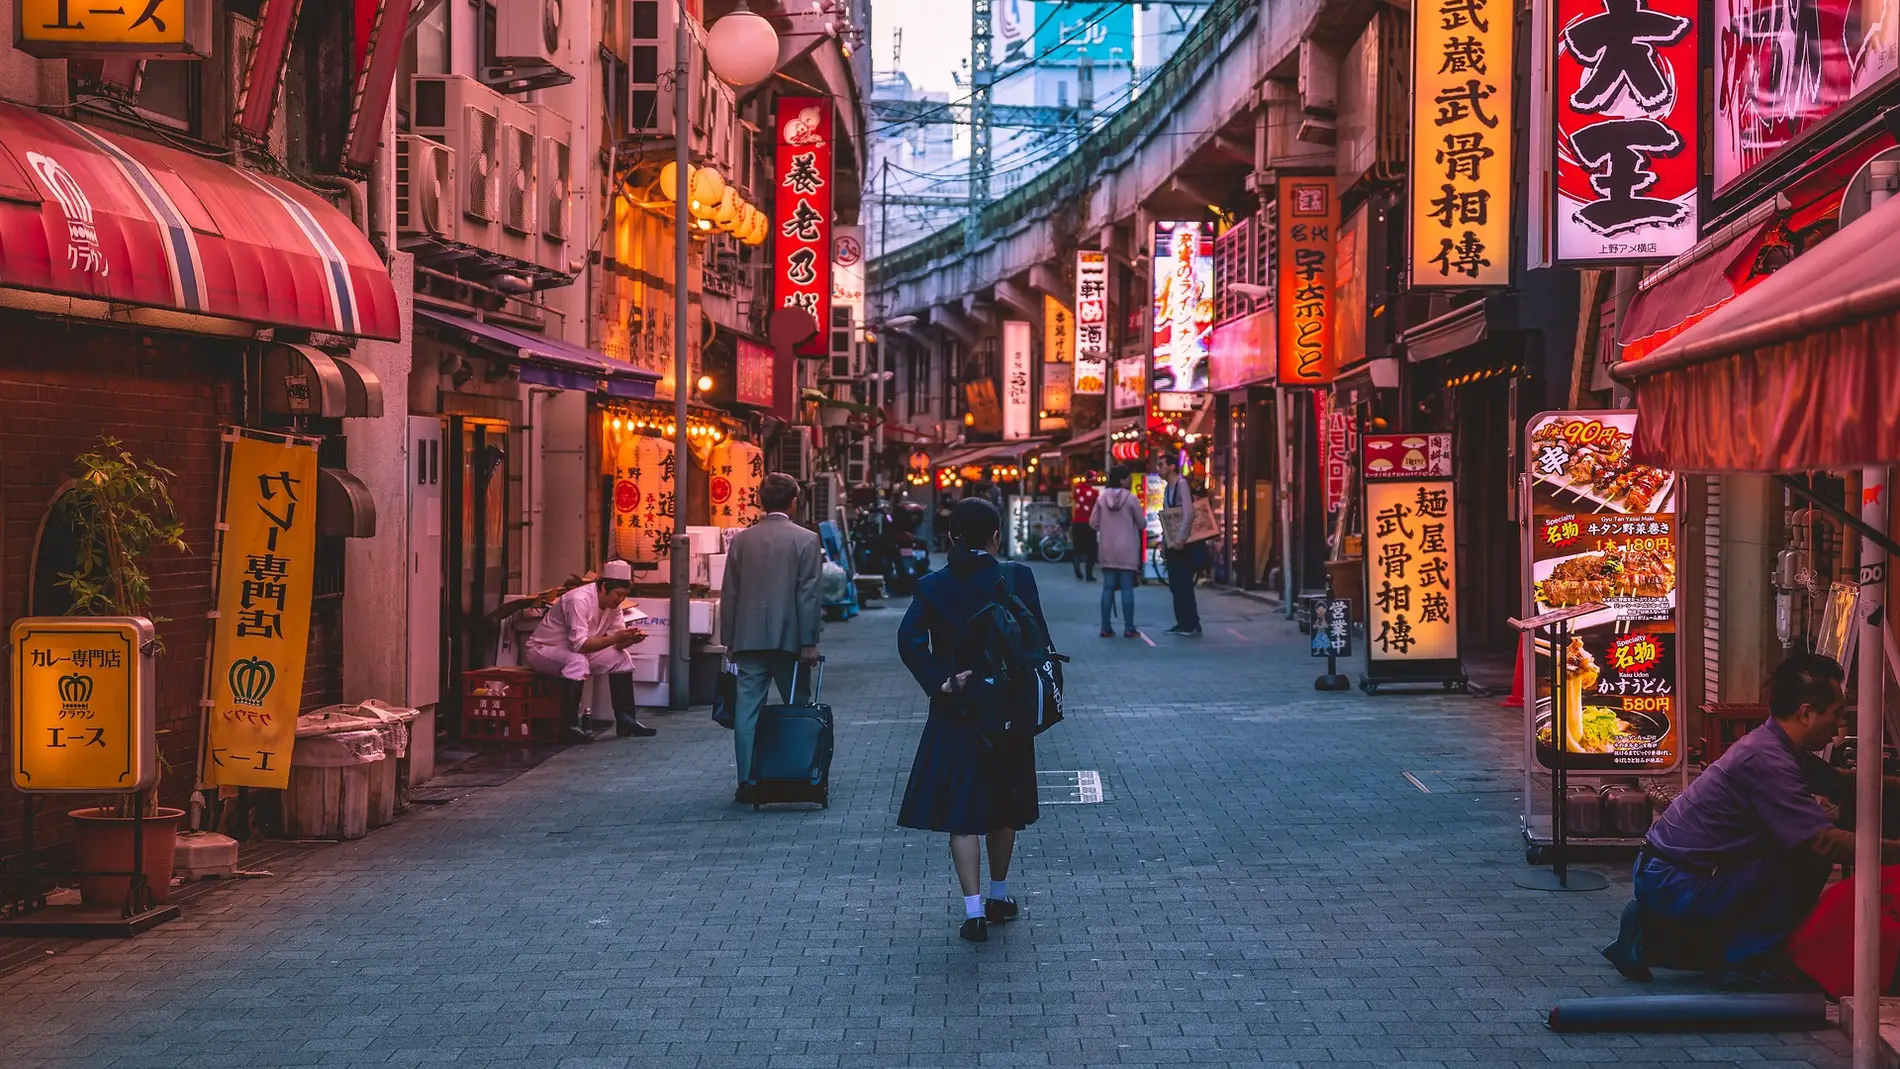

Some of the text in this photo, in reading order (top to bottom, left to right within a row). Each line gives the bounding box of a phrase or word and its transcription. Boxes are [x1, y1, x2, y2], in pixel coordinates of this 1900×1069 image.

[42, 0, 166, 32] エース
[1565, 0, 1692, 238] 大王
[67, 245, 109, 277] クラウン
[1599, 243, 1657, 255] 上野アメ横店
[1538, 446, 1570, 476] 串
[1546, 521, 1580, 545] 名物
[1587, 522, 1670, 536] 牛タン野菜巻き
[1415, 486, 1451, 624] 麺屋武蔵
[1375, 503, 1417, 655] 武骨相傳
[1329, 600, 1348, 654] 営業中
[1616, 635, 1647, 647] Specialty
[30, 649, 121, 668] カレー専門店
[1614, 642, 1656, 669] 名物
[1598, 678, 1672, 695] かすうどん
[58, 710, 96, 720] クラウン
[1622, 696, 1670, 712] 580円
[46, 727, 107, 748] エース
